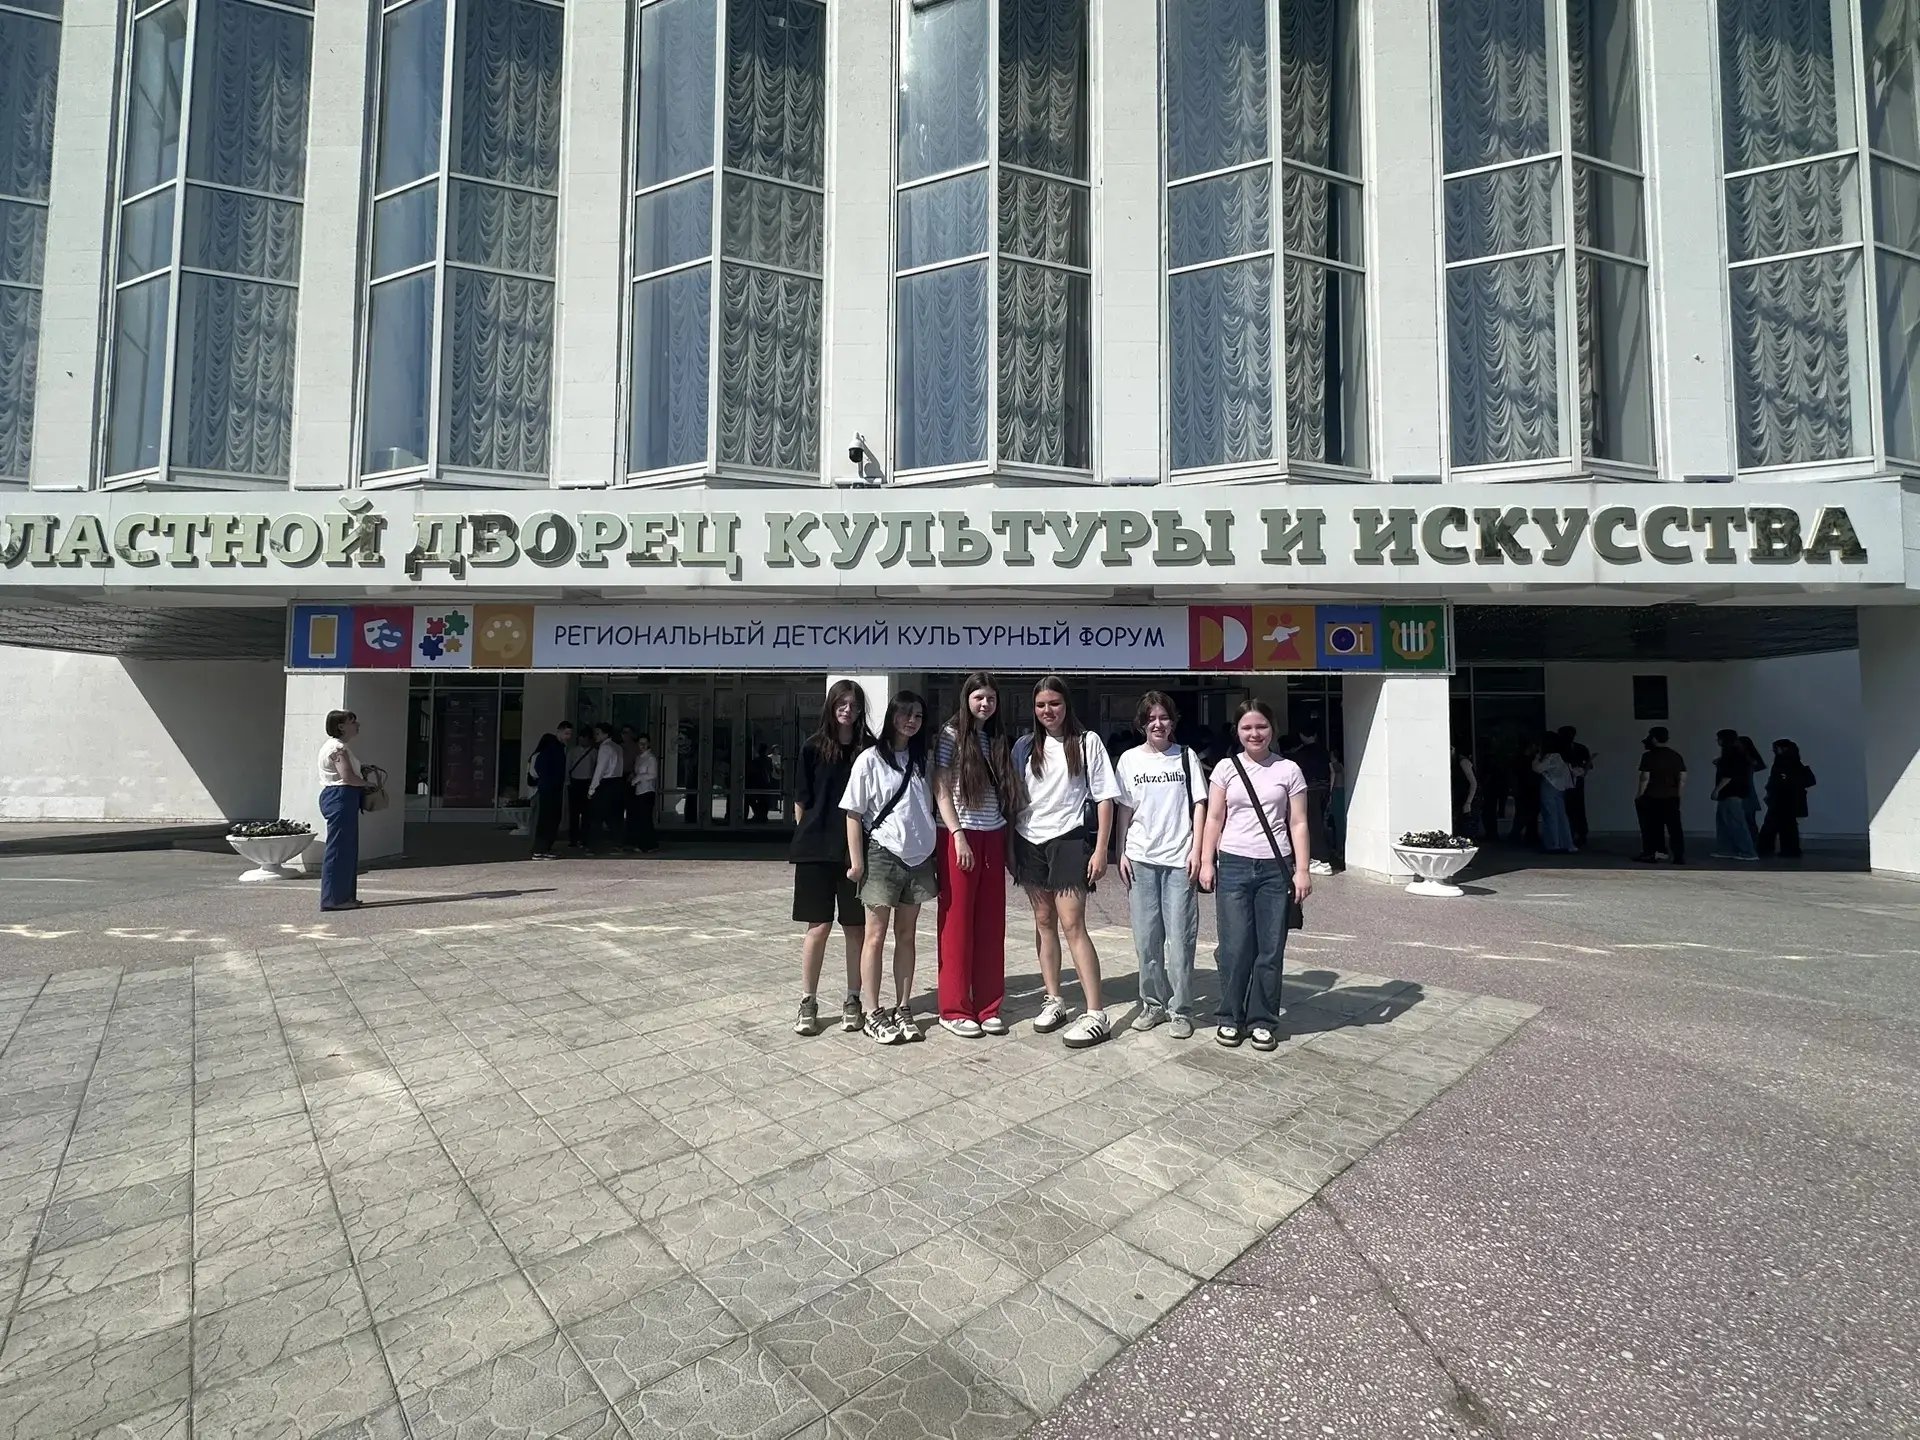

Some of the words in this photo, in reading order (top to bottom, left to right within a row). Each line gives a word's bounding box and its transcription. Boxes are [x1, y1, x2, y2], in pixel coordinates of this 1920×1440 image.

[0, 496, 387, 568] ЛАСТНОЙ
[404, 514, 742, 581] ДВОРЕЦ
[763, 510, 1236, 569] КУЛЬТУРЫ
[1259, 509, 1329, 567] И
[1352, 506, 1869, 566] ИСКУССТВА
[554, 620, 765, 646] РЕГИОНАЛЬНЫЙ
[772, 620, 890, 649] ДЕТСКИЙ
[898, 620, 1072, 647] КУЛЬТУРНЫЙ
[1078, 624, 1166, 648] ФОРУМ
